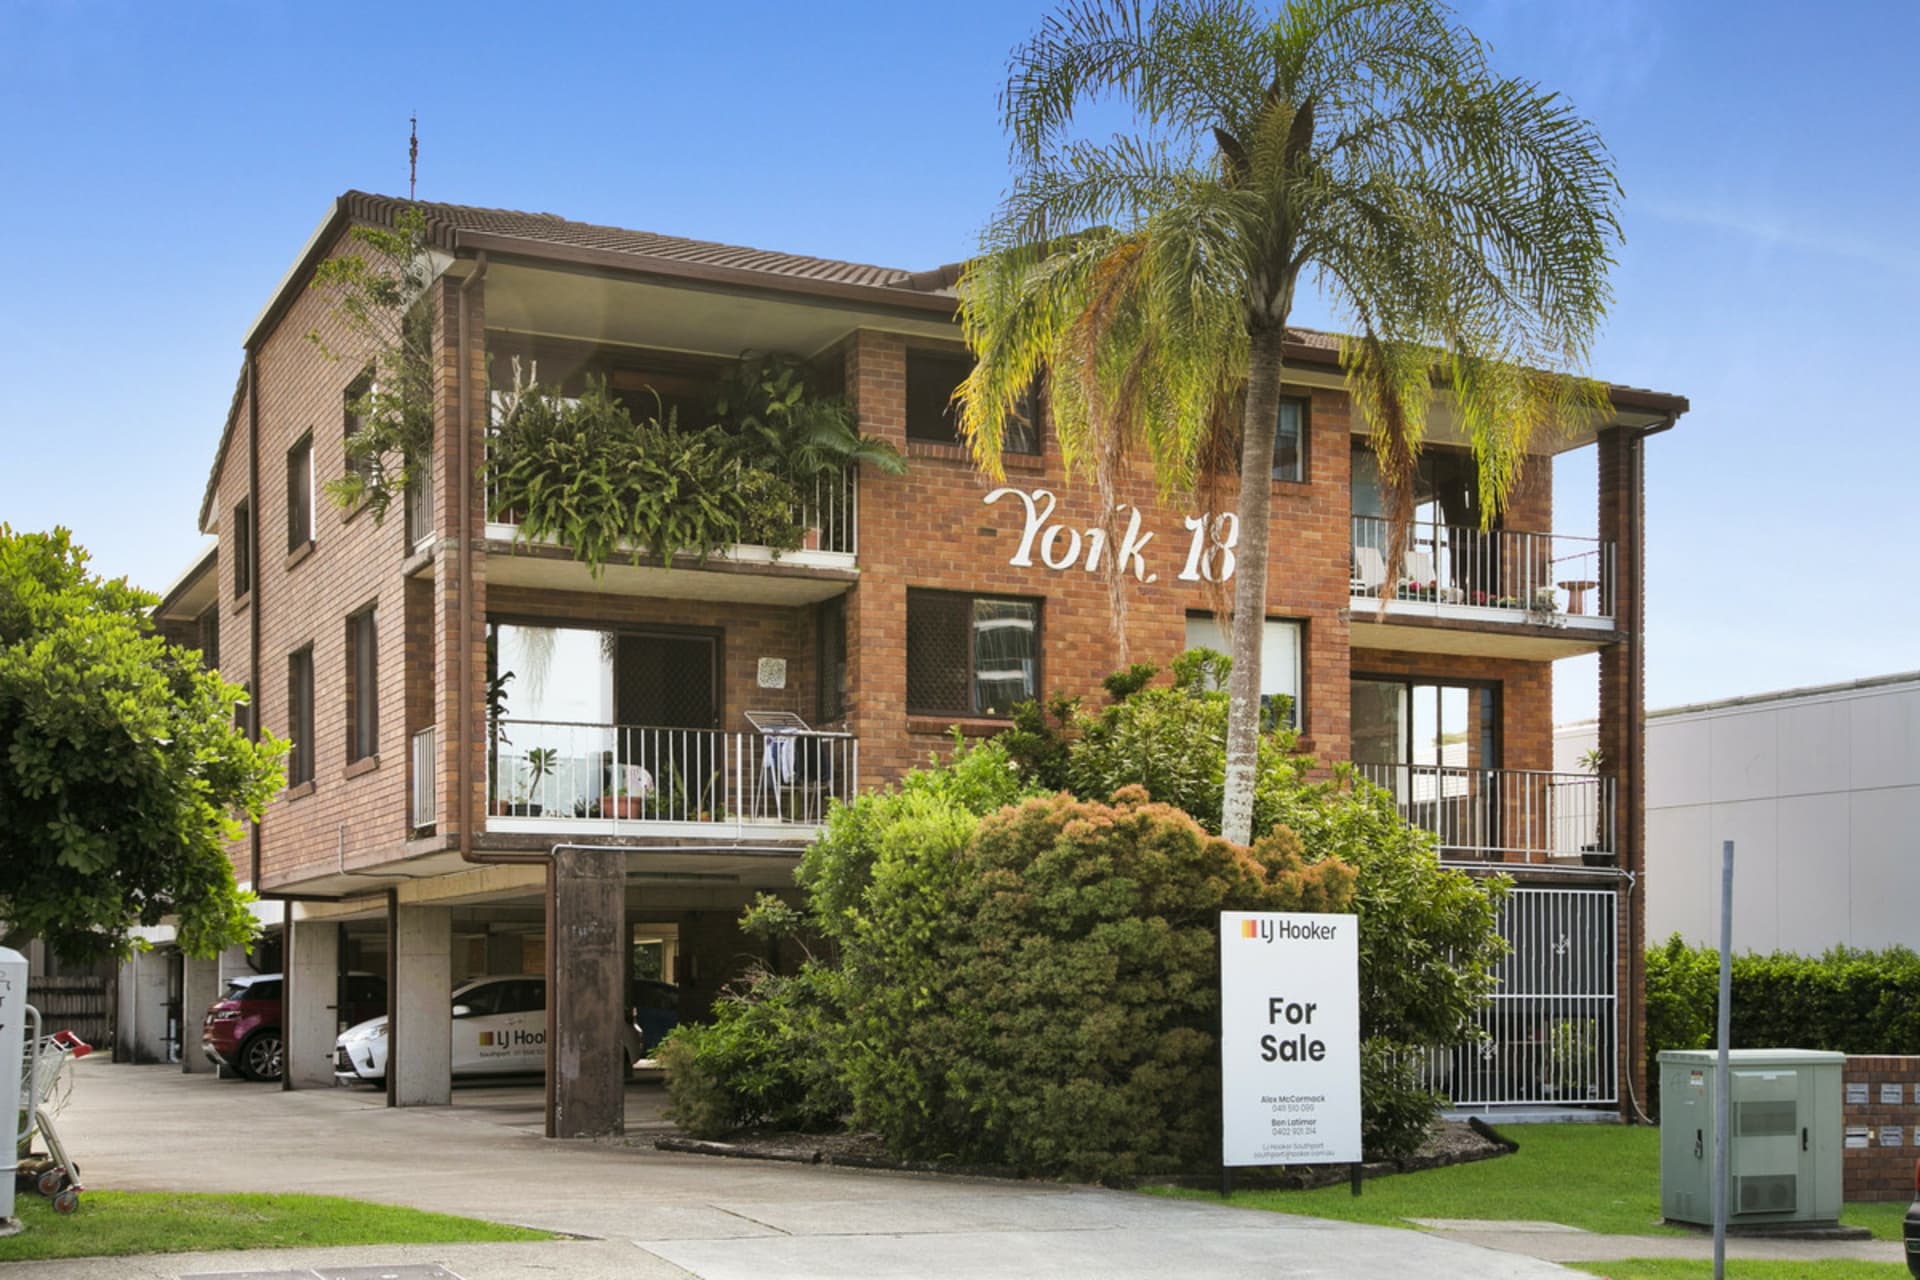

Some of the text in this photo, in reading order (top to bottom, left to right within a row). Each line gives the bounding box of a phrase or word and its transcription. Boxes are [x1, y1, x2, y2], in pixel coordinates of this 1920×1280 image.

[983, 488, 1157, 583] York
[1261, 919, 1337, 944] LJ Hooker
[1269, 996, 1318, 1025] For
[497, 1029, 546, 1049] LJ Hoo
[1260, 1033, 1327, 1063] Sale
